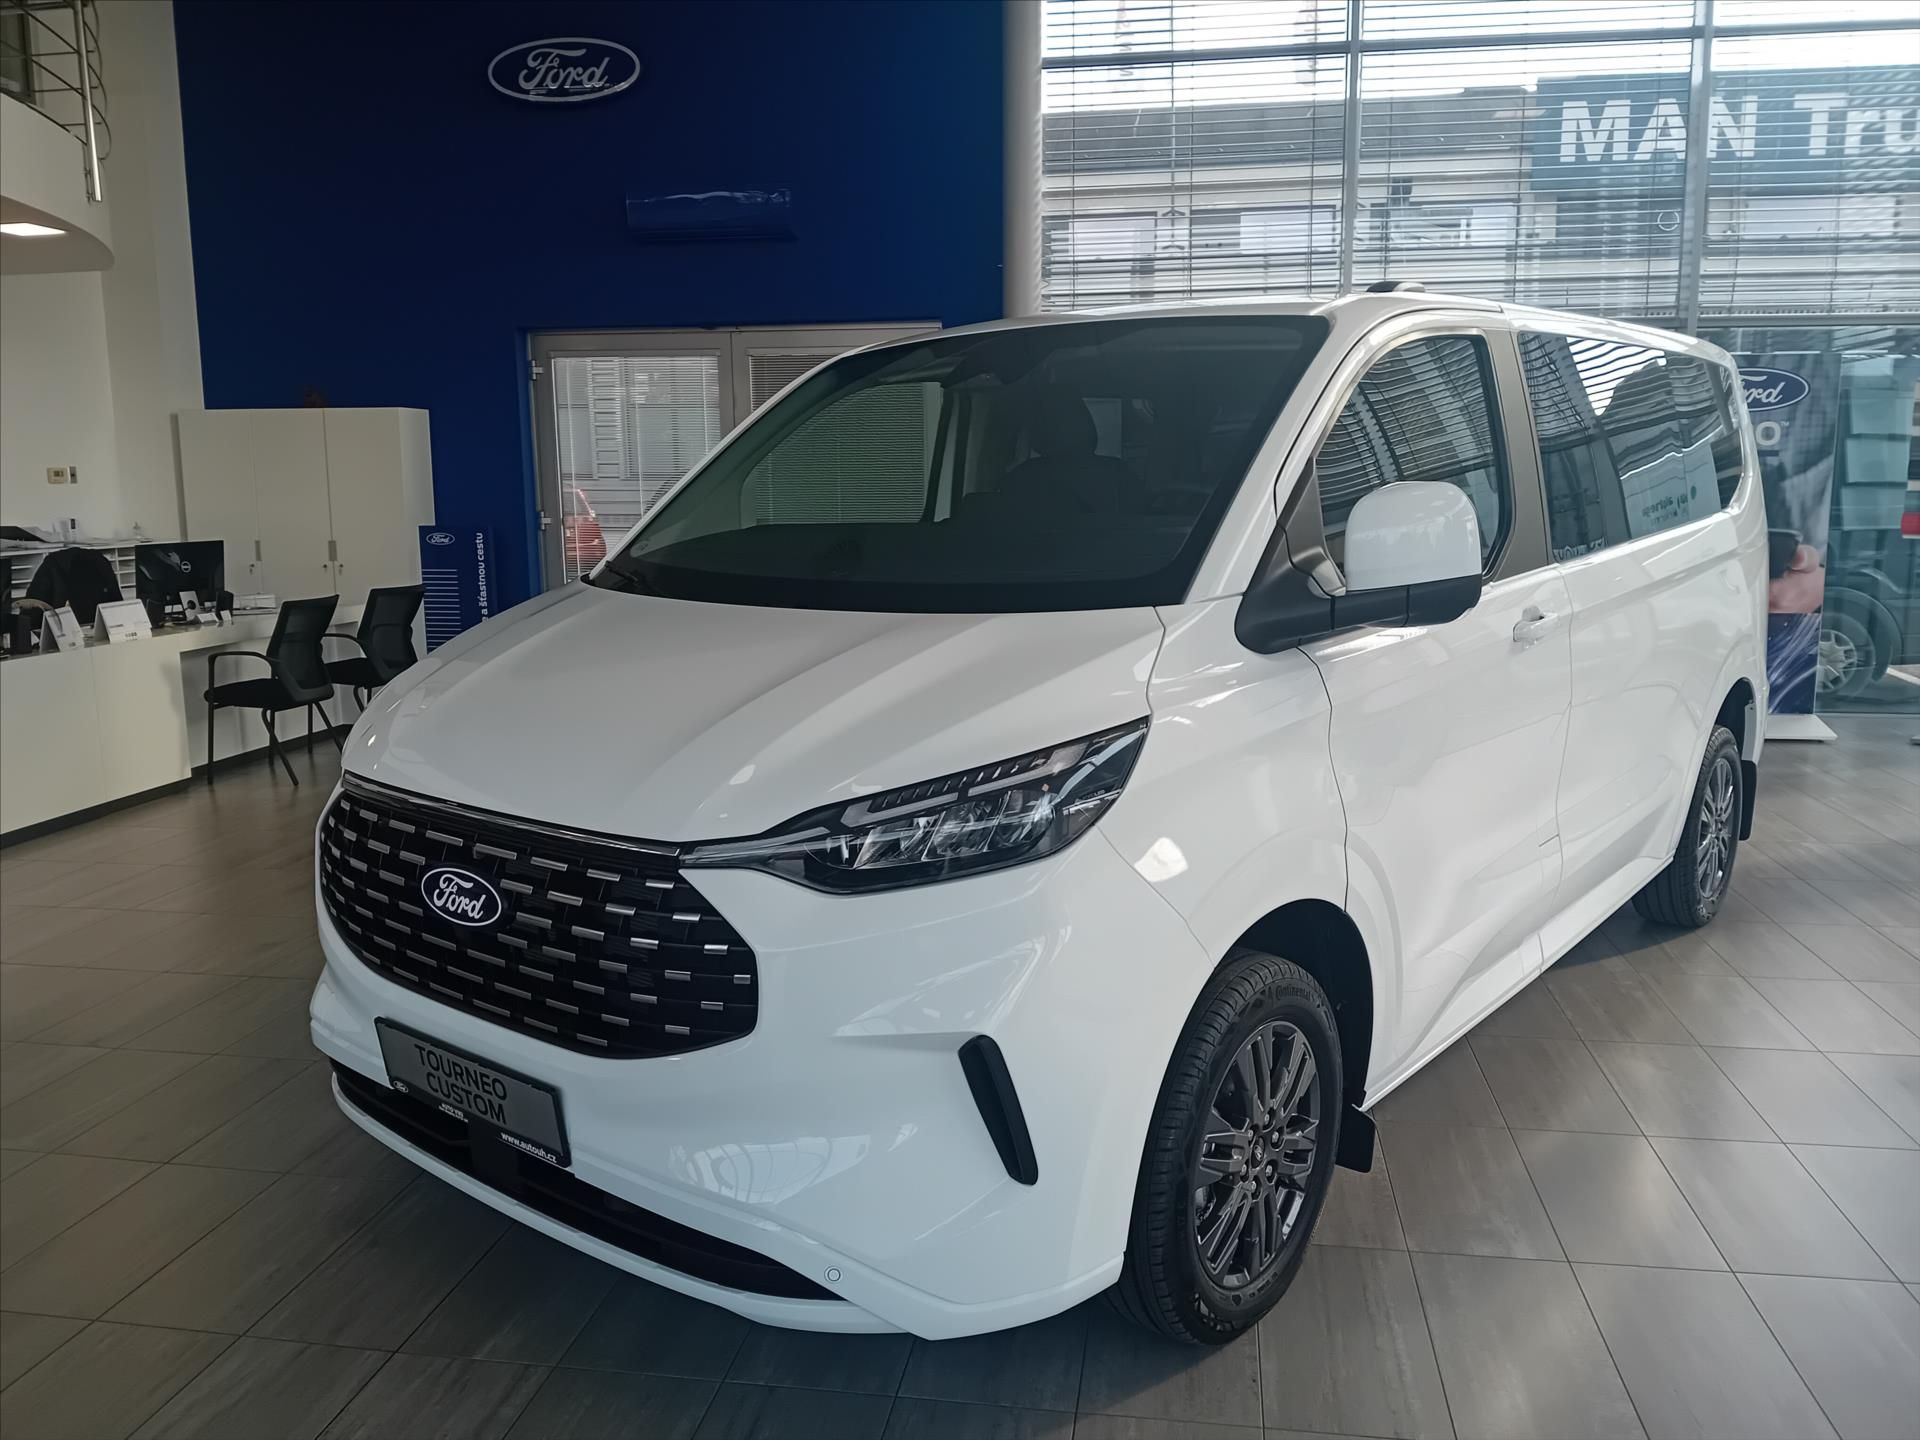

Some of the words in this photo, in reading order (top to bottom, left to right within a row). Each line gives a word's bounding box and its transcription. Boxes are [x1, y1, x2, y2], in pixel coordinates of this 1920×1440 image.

[518, 48, 610, 90] Ford
[1560, 96, 1759, 163] MAN
[1794, 92, 1920, 157] Tru
[475, 533, 485, 560] cestu
[433, 874, 487, 919] Ford
[414, 1043, 507, 1101] TOURNEO
[426, 1072, 507, 1125] CUSTOM
[500, 1132, 557, 1163] www.autouh.cz
